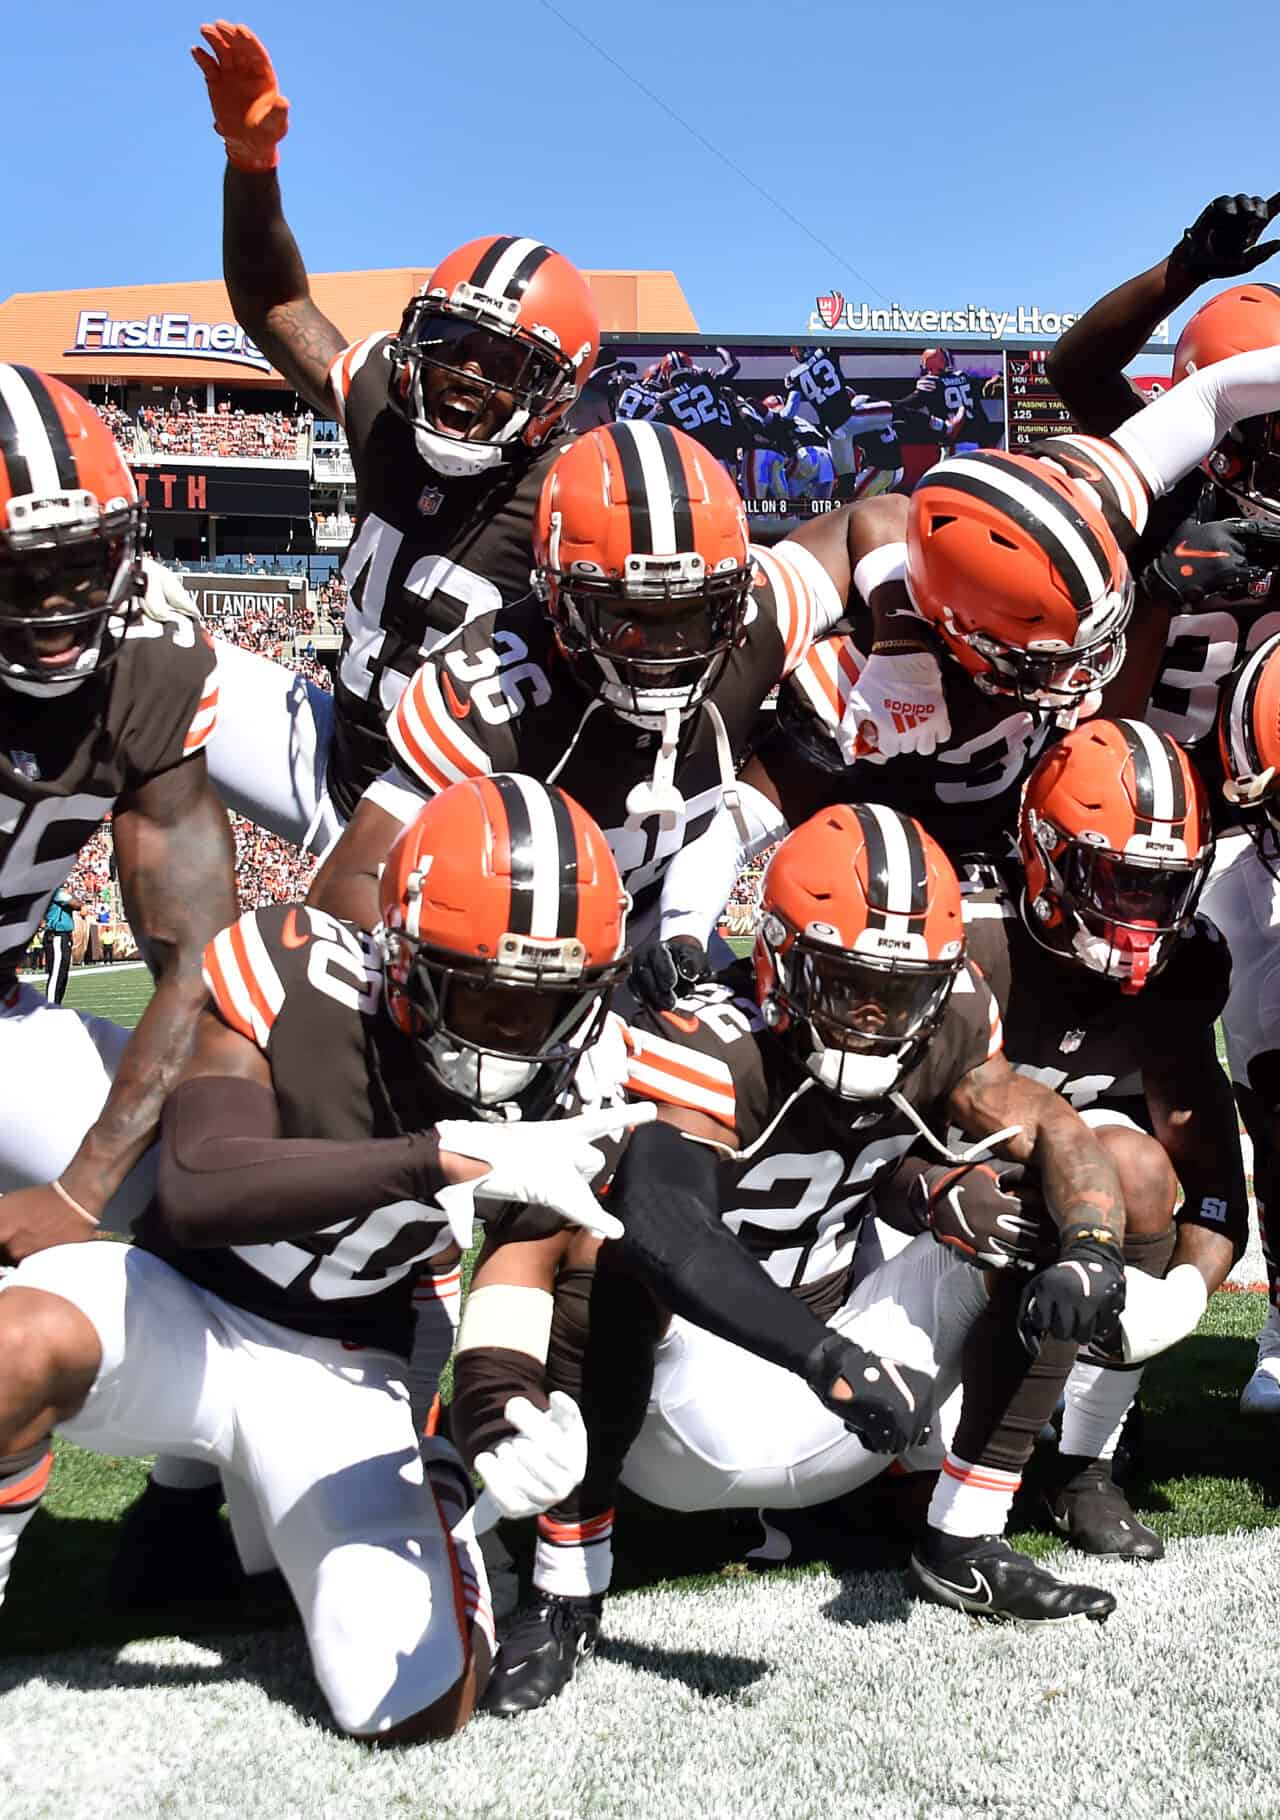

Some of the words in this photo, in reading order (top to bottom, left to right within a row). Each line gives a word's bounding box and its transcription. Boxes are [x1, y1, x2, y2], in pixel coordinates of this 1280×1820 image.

[846, 304, 1009, 340] University
[1017, 306, 1084, 335] Hos
[800, 358, 842, 405] 43
[1013, 385, 1027, 394] 14
[668, 384, 719, 431] 52
[1013, 410, 1033, 419] 125
[1017, 434, 1031, 443] 61
[761, 500, 776, 513] ON
[780, 500, 787, 513] 8
[812, 500, 832, 513] QTR
[444, 630, 552, 726] 36
[884, 698, 935, 715] adidas
[1200, 1196, 1228, 1223] 51
